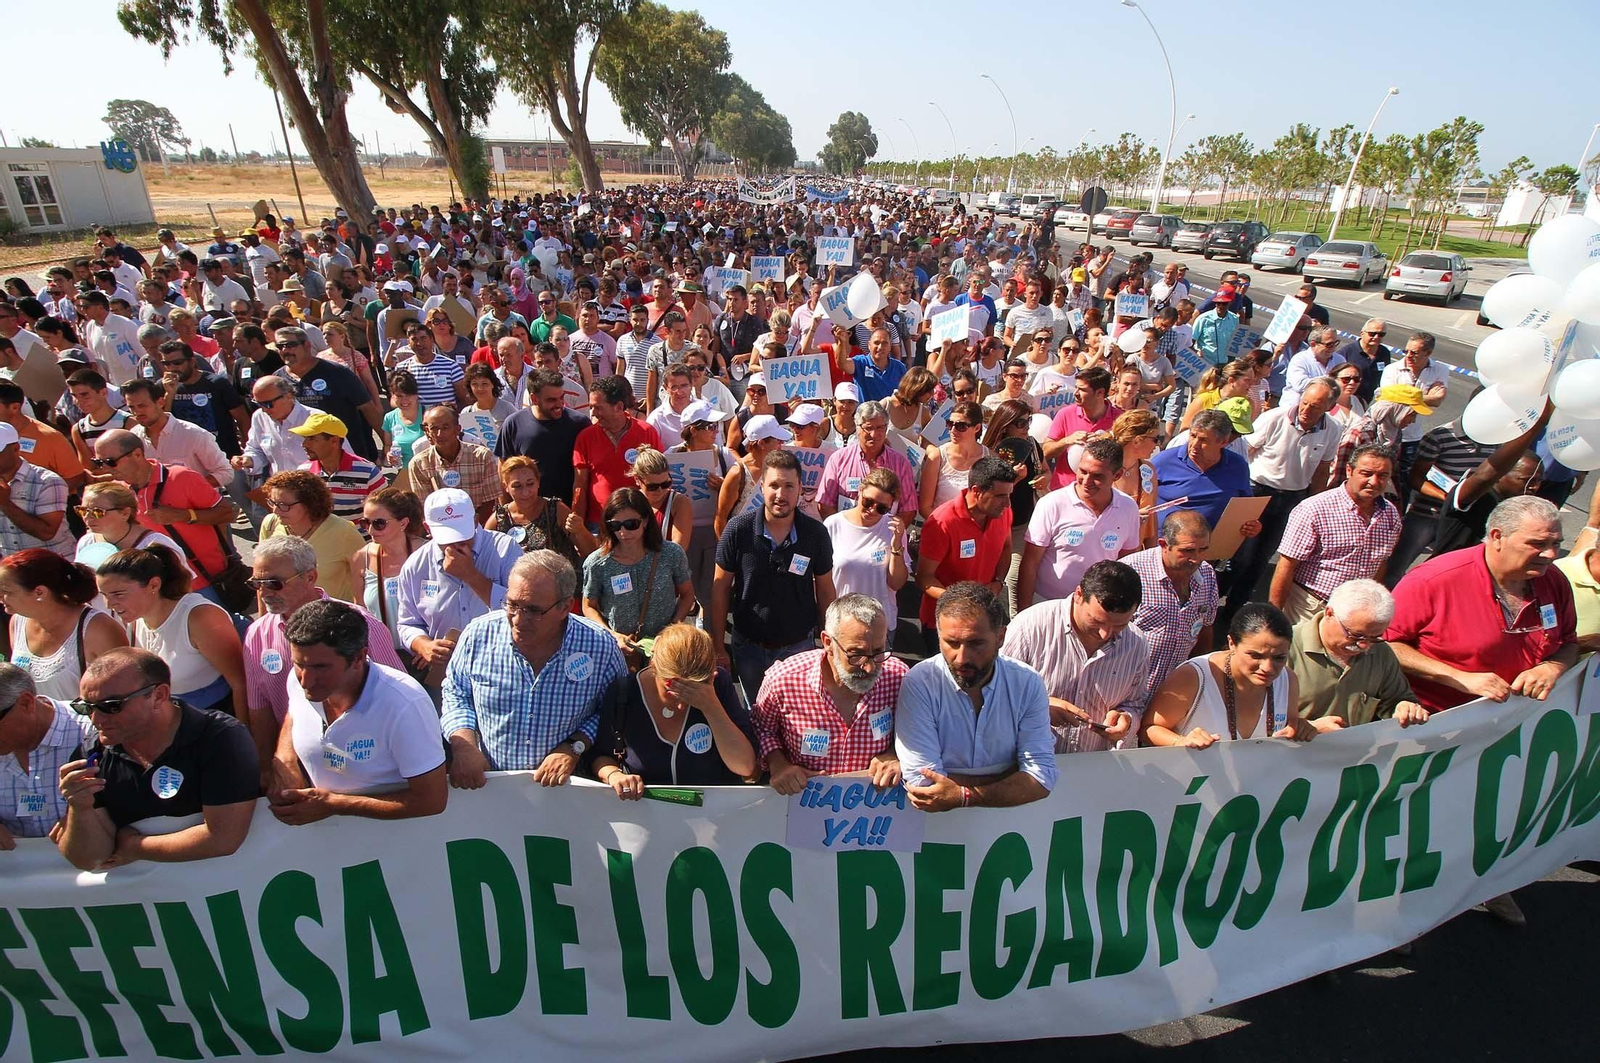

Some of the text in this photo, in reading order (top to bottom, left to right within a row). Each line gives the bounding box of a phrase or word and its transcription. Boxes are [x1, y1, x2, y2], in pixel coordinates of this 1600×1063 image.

[827, 280, 849, 312] ¡¡AG
[769, 358, 821, 381] ¡¡AGUA
[783, 379, 818, 400] YA!!
[475, 415, 497, 452] ¡¡AGU
[689, 467, 710, 501] YA!!
[346, 739, 375, 753] ¡¡AGUA
[686, 727, 711, 745] ¡¡AGUA
[693, 739, 709, 752] YA!!
[353, 750, 371, 761] YA!!
[800, 780, 906, 813] ¡¡AGUA
[822, 815, 893, 847] YA!!
[0, 859, 431, 1063] EFENSA
[446, 835, 588, 1021] DE
[606, 841, 801, 1029] LOS
[836, 775, 1311, 1021] REGADÍOS
[1301, 744, 1463, 913] DEL
